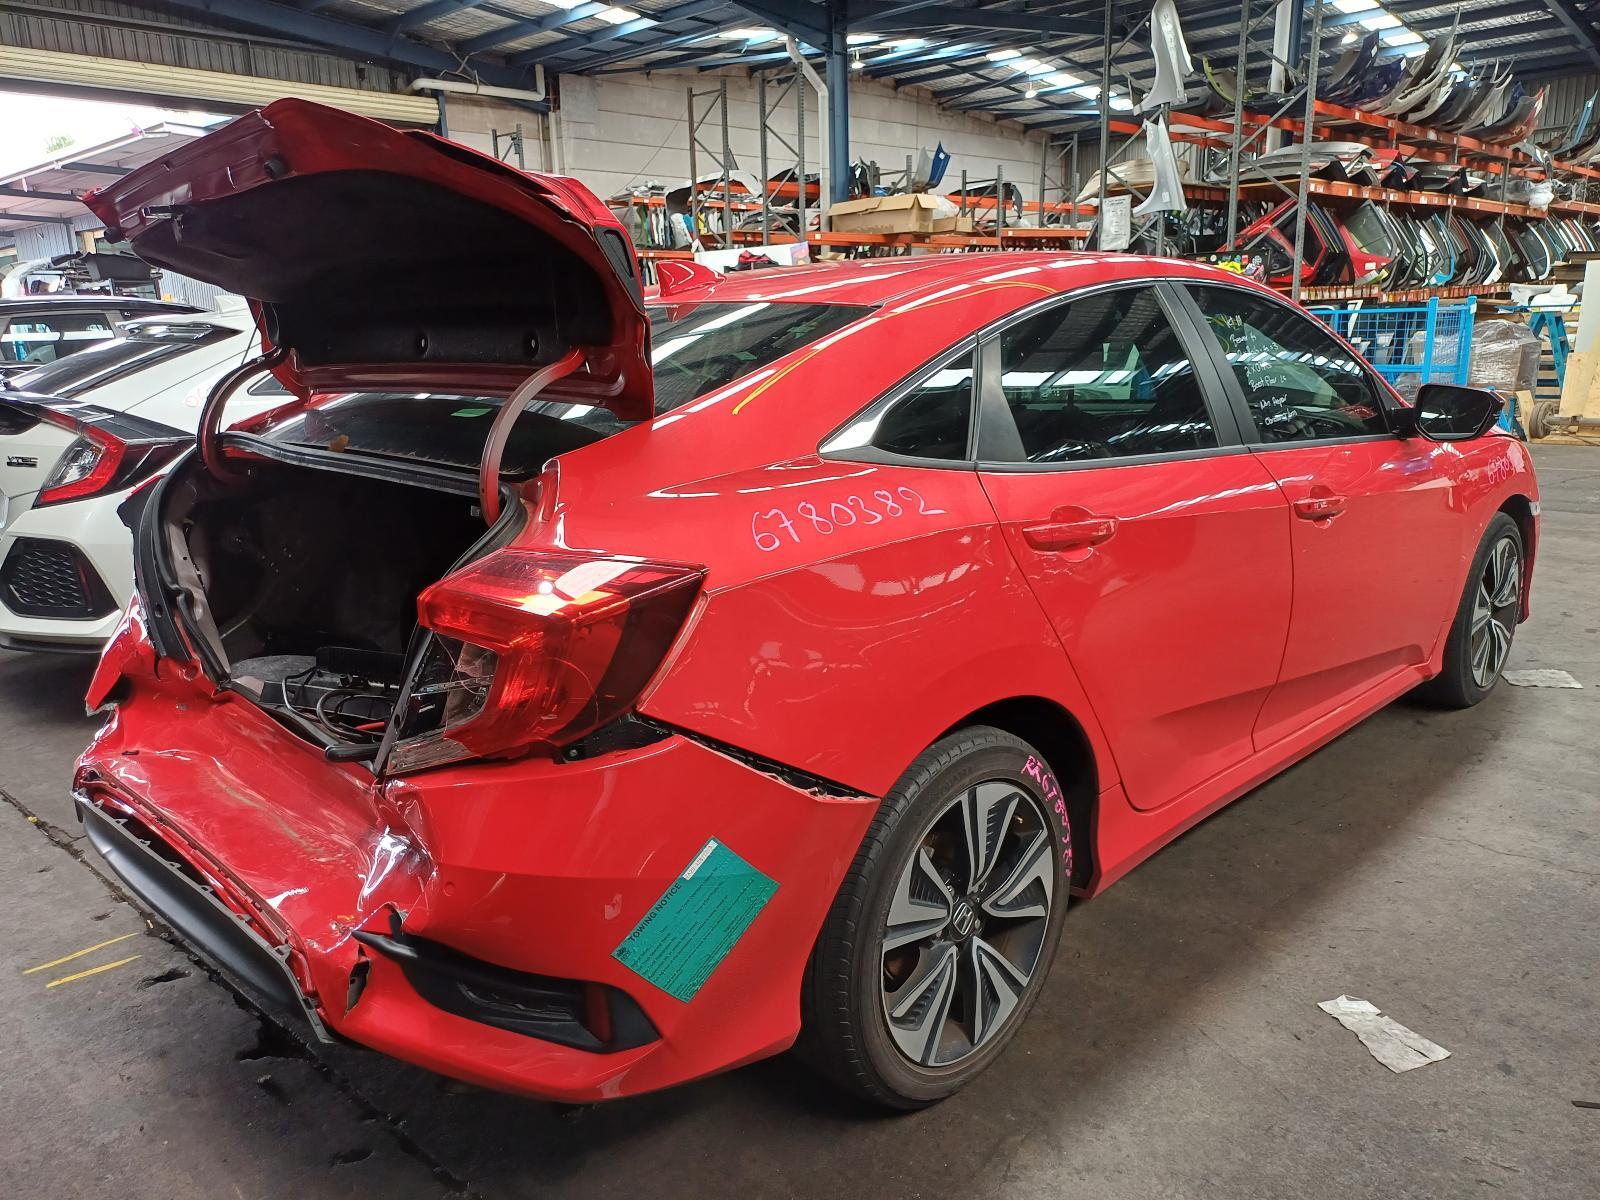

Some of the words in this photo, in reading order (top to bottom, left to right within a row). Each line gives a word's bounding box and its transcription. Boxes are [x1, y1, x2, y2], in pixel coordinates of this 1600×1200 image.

[751, 486, 947, 552] 6780382
[628, 912, 657, 942] TOWING
[656, 882, 682, 914] NOTICE
